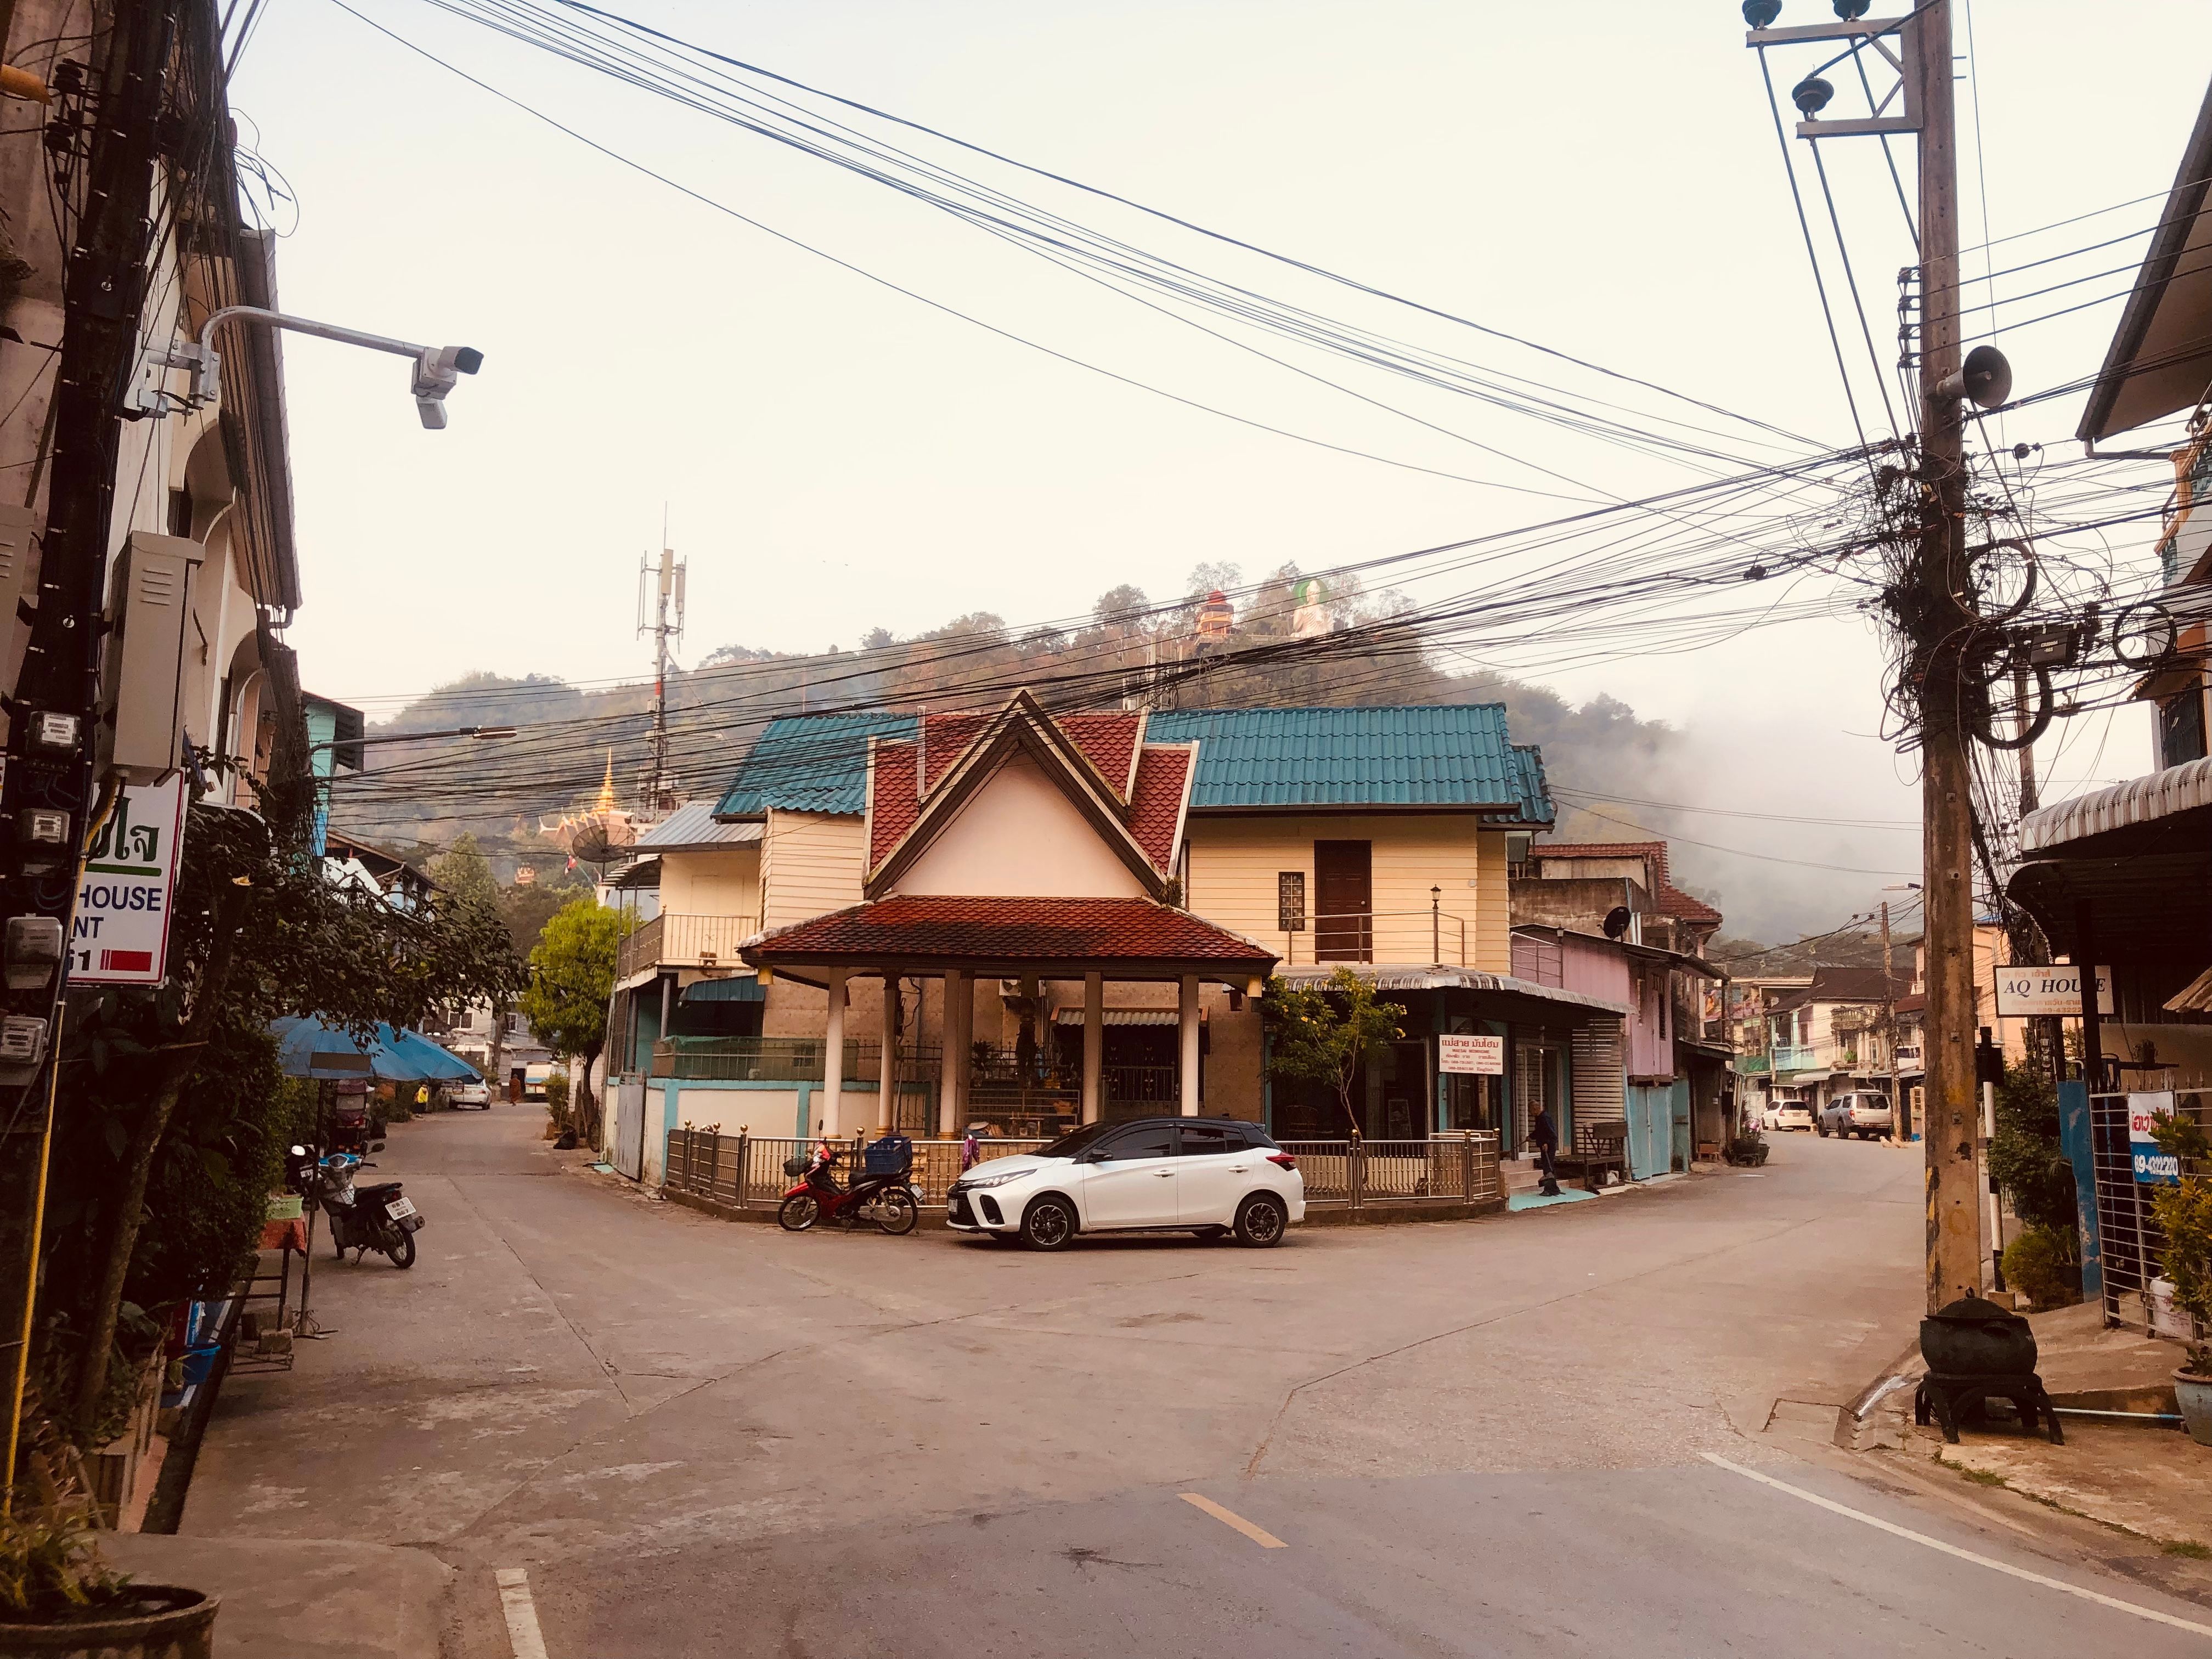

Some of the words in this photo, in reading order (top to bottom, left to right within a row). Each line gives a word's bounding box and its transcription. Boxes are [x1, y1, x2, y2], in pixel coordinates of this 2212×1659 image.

[2004, 980, 2031, 997] AQ
[2040, 978, 2106, 993] HOUE
[1442, 1037, 1469, 1047] แม่สาย
